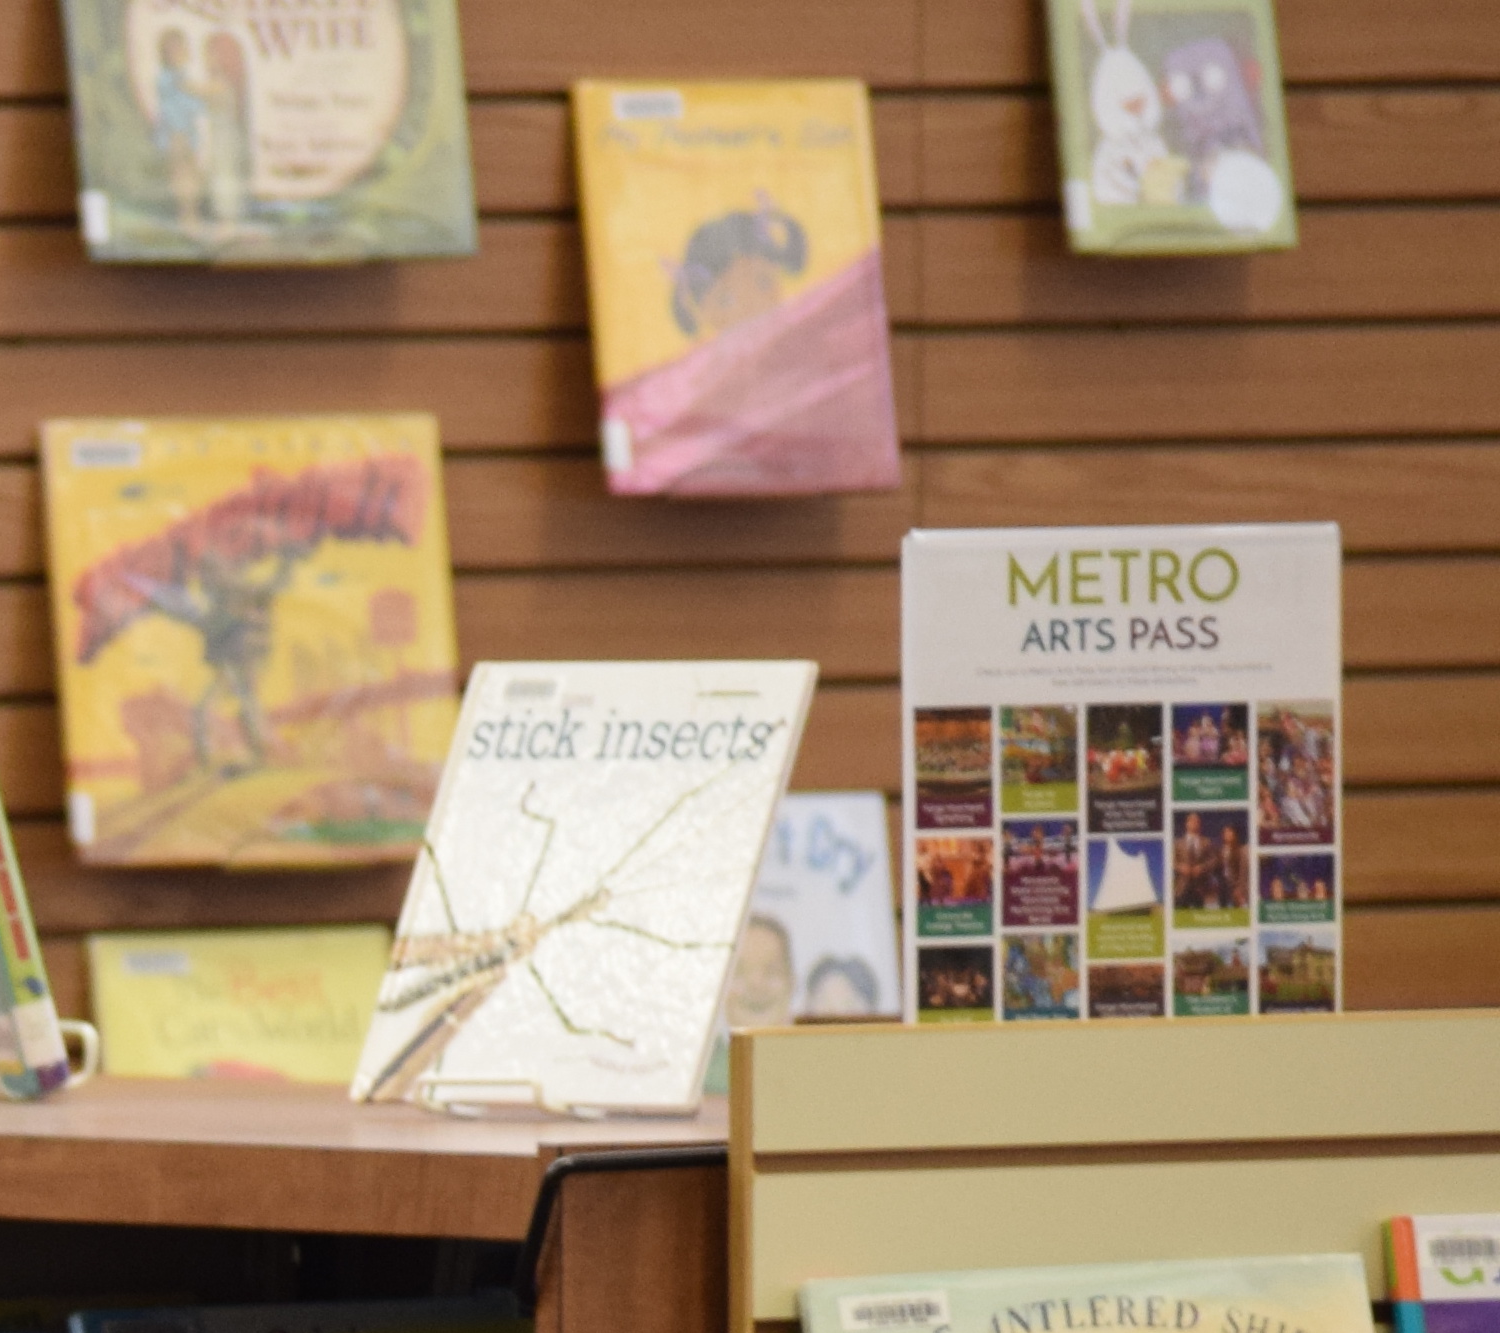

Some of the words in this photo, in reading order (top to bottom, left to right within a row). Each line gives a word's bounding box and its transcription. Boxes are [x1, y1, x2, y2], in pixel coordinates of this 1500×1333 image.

[1006, 547, 1240, 606] METRO
[1020, 617, 1116, 653] ARTS
[1129, 615, 1220, 651] PASS
[466, 708, 586, 761] stick
[597, 708, 776, 762] insects
